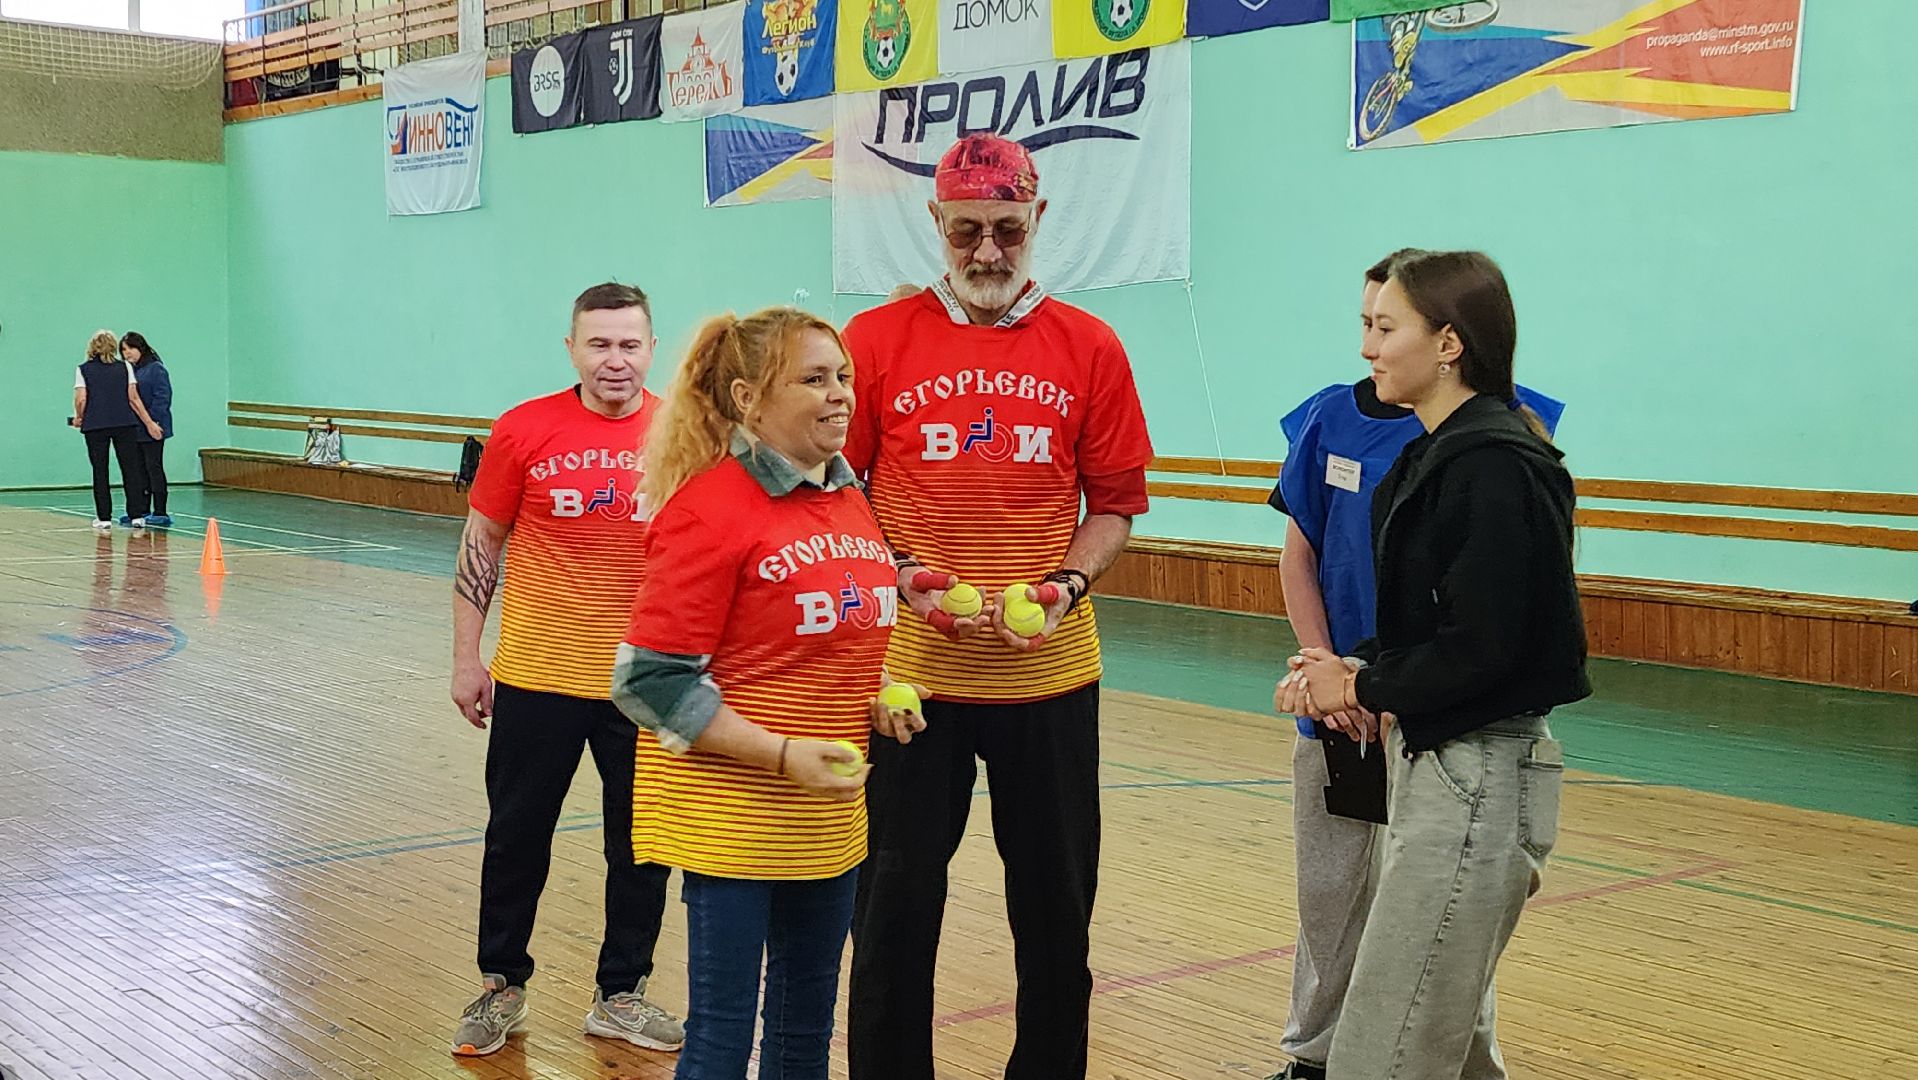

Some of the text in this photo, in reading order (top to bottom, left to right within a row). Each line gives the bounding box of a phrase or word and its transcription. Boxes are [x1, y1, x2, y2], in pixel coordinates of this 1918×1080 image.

[1646, 20, 1794, 49] propaganda@minstm.gov.ru
[1700, 36, 1793, 57] www.rf-sport.info
[874, 47, 1150, 144] ПРОЛИВ
